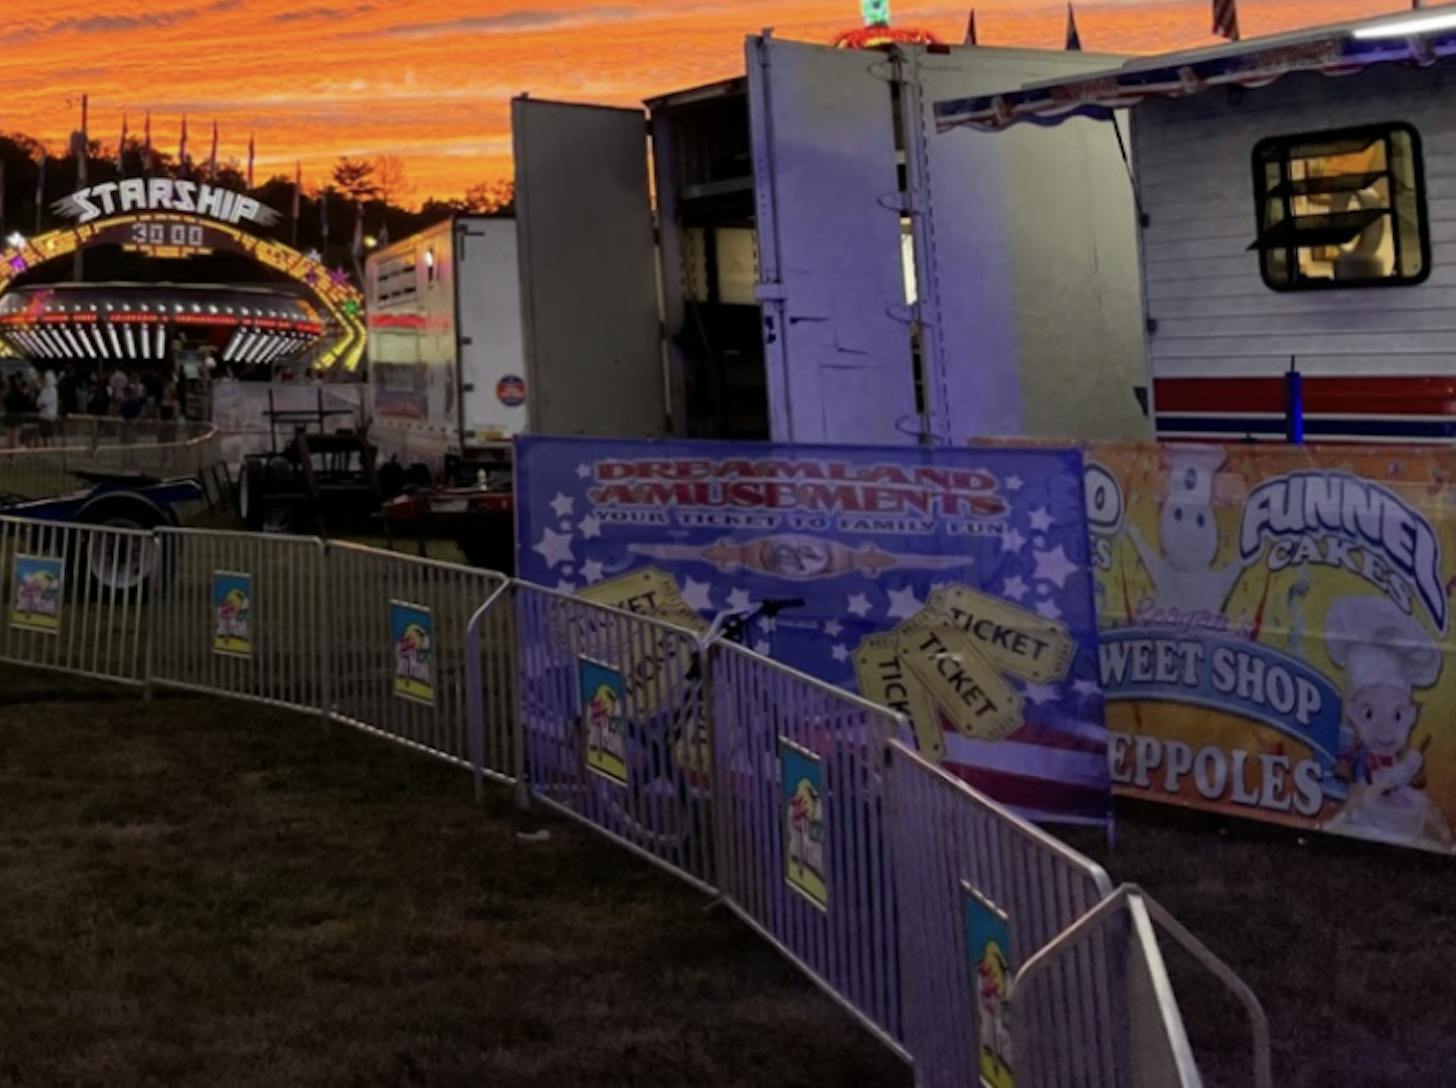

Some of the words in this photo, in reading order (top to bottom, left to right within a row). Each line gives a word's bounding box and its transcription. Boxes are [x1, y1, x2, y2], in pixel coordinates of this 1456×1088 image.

[72, 177, 262, 224] STARSHIP
[588, 481, 1009, 519] AMUSEMENTS
[595, 458, 997, 492] DREAMLAND
[596, 511, 666, 524] YOUR
[682, 513, 777, 527] TICKET
[794, 517, 828, 529] TO
[840, 518, 936, 532] FAMILY
[950, 521, 1006, 535] FUN
[1240, 472, 1445, 632] FUNNEL
[1268, 536, 1414, 611] CAKES
[950, 606, 1049, 661] TICKET
[878, 656, 922, 751] TICK
[919, 631, 999, 717] TICKET
[1100, 639, 1205, 687] WEET
[1211, 646, 1322, 726] SHOP
[1107, 731, 1324, 816] EPPOLES
